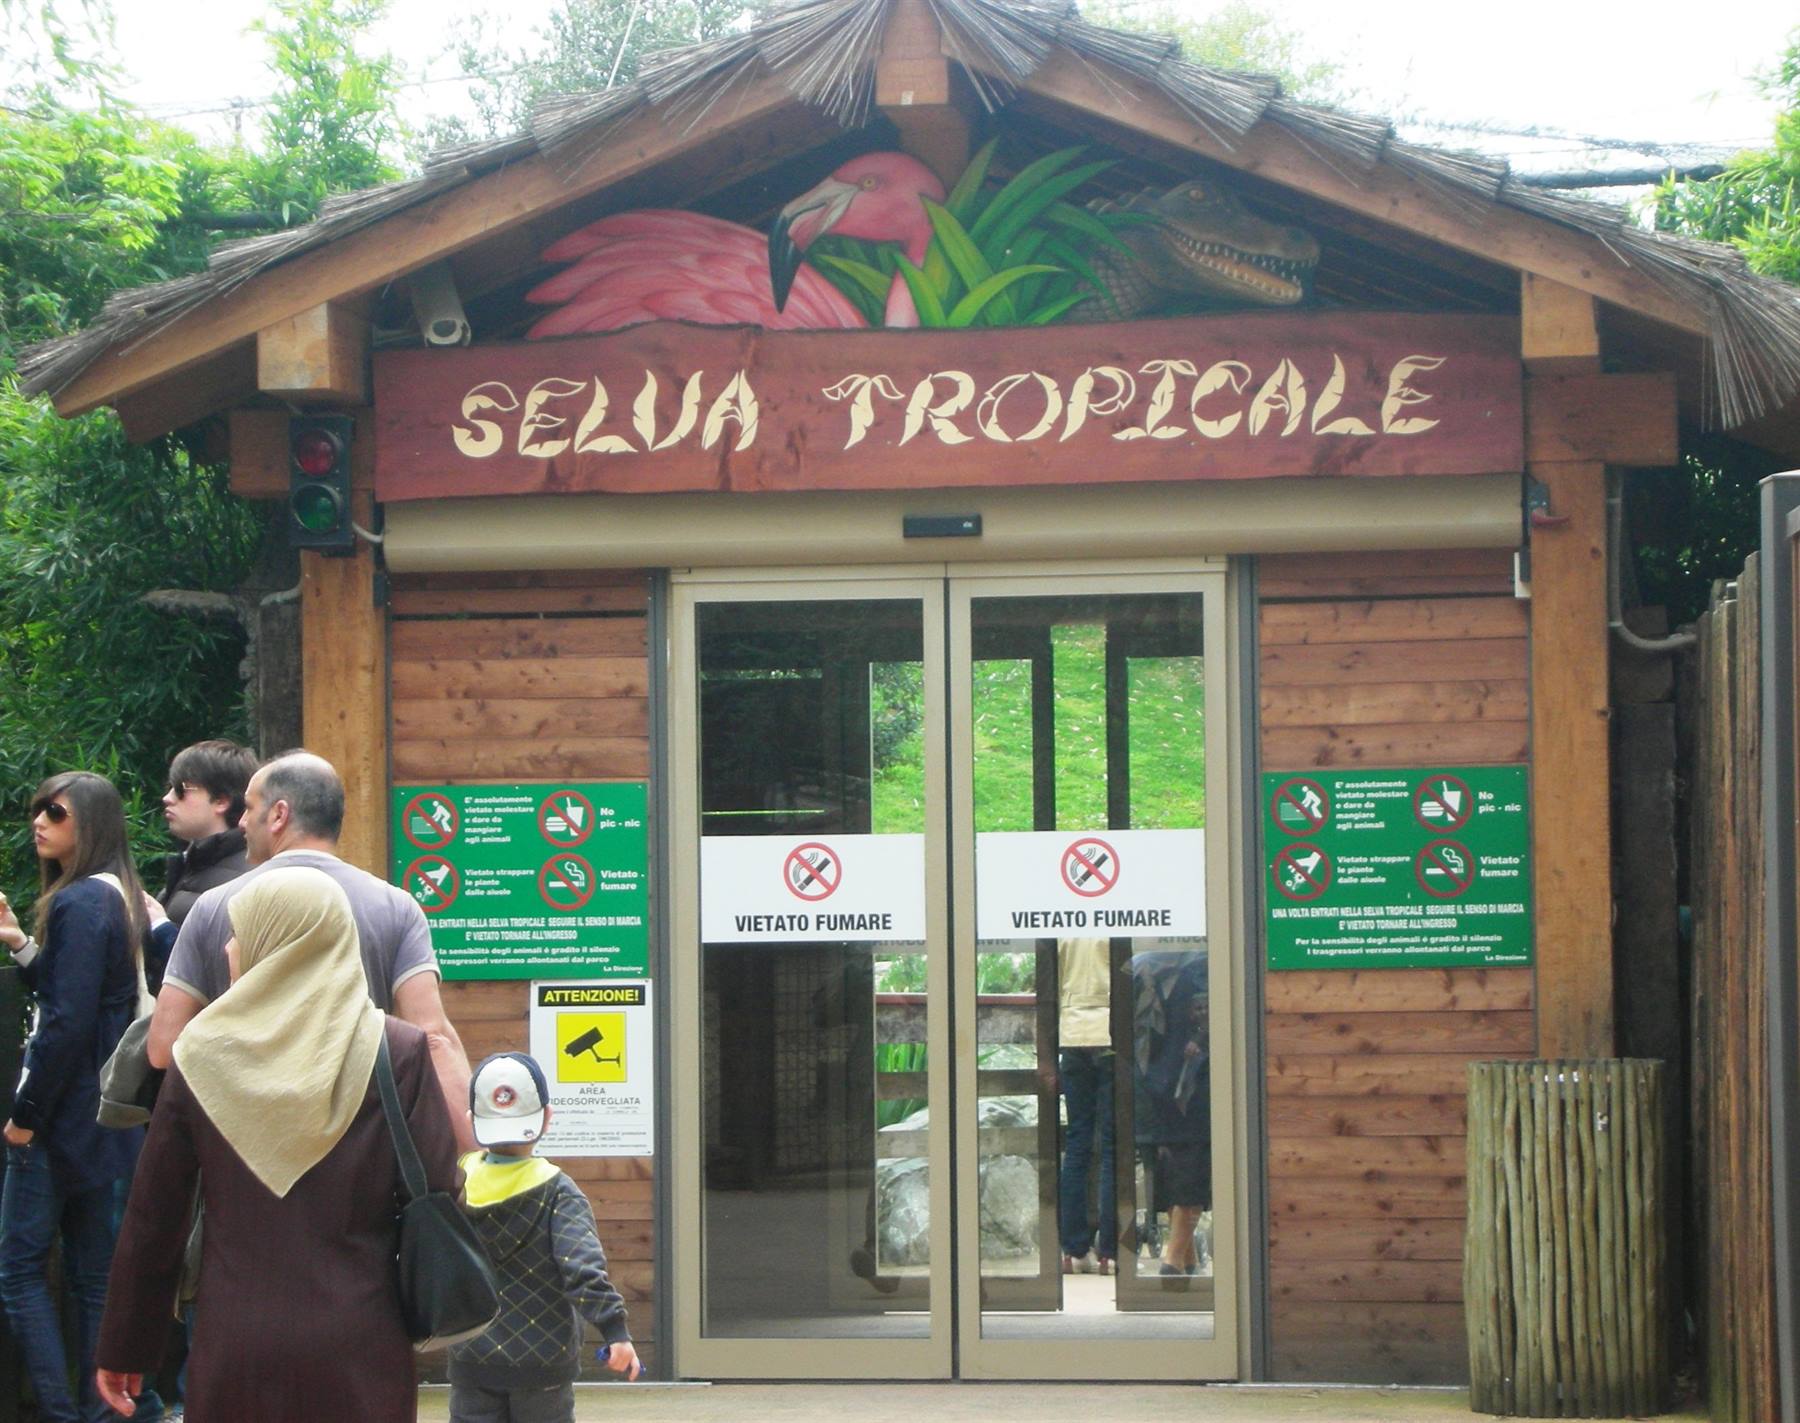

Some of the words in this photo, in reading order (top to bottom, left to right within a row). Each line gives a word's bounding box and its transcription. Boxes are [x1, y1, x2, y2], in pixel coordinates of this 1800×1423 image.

[452, 369, 759, 457] SELVA
[822, 354, 1444, 450] TROPICALE
[735, 915, 808, 932] VIETATO
[816, 914, 891, 931] FUMARE
[1012, 911, 1086, 928] VIETATO
[1094, 910, 1171, 927] FUMARE
[544, 990, 638, 1002] ATTENZIONE!
